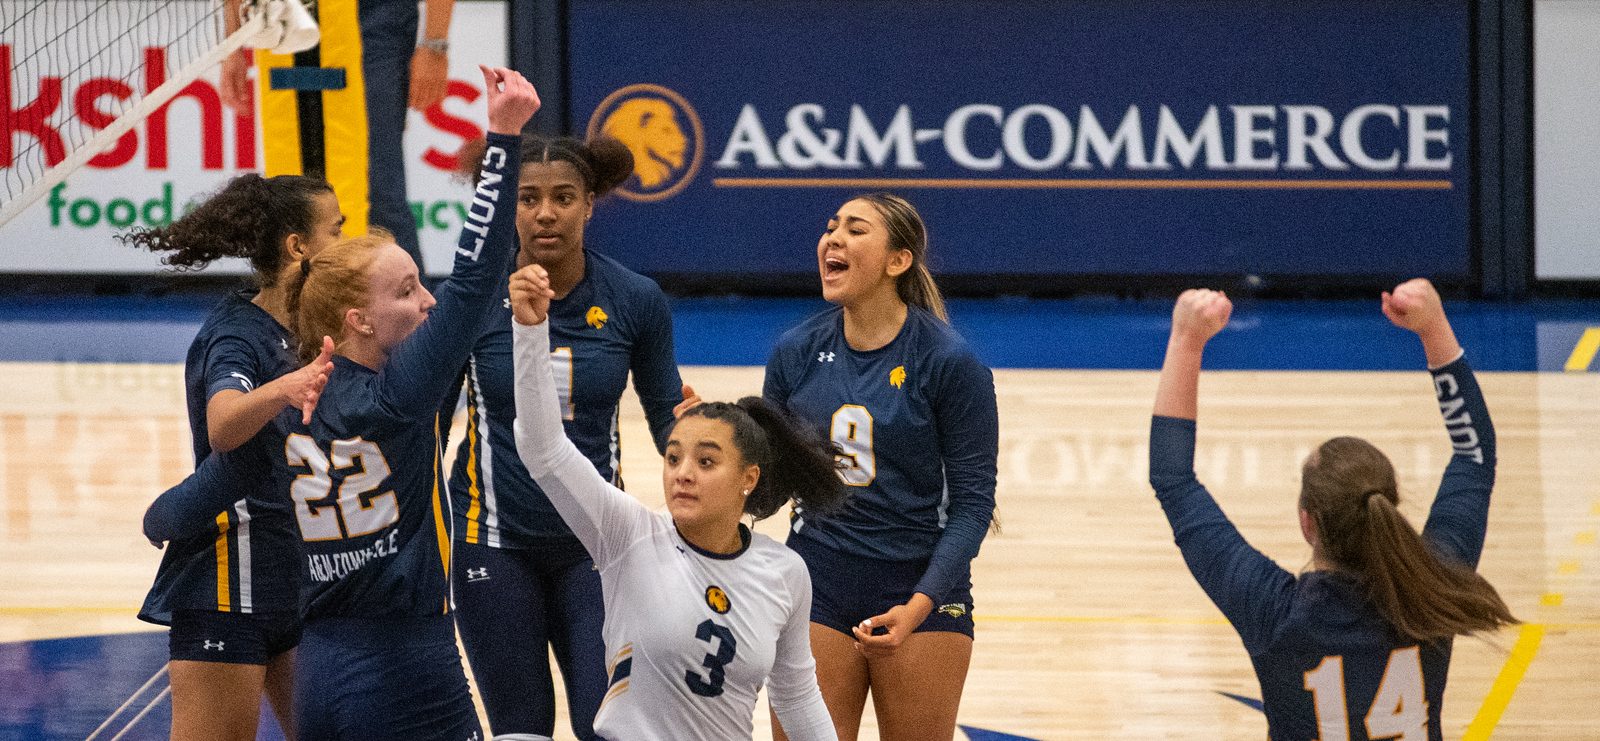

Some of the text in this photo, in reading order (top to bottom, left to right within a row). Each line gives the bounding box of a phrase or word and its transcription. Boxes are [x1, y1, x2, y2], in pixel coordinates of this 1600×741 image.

[717, 102, 1453, 172] A&M-COMMERCE
[47, 181, 174, 228] food
[455, 145, 507, 262] LIONS
[830, 403, 876, 487] 9
[1434, 372, 1484, 465] IONS
[284, 432, 400, 542] 22
[684, 618, 737, 698] 3
[1303, 645, 1429, 741] 14
